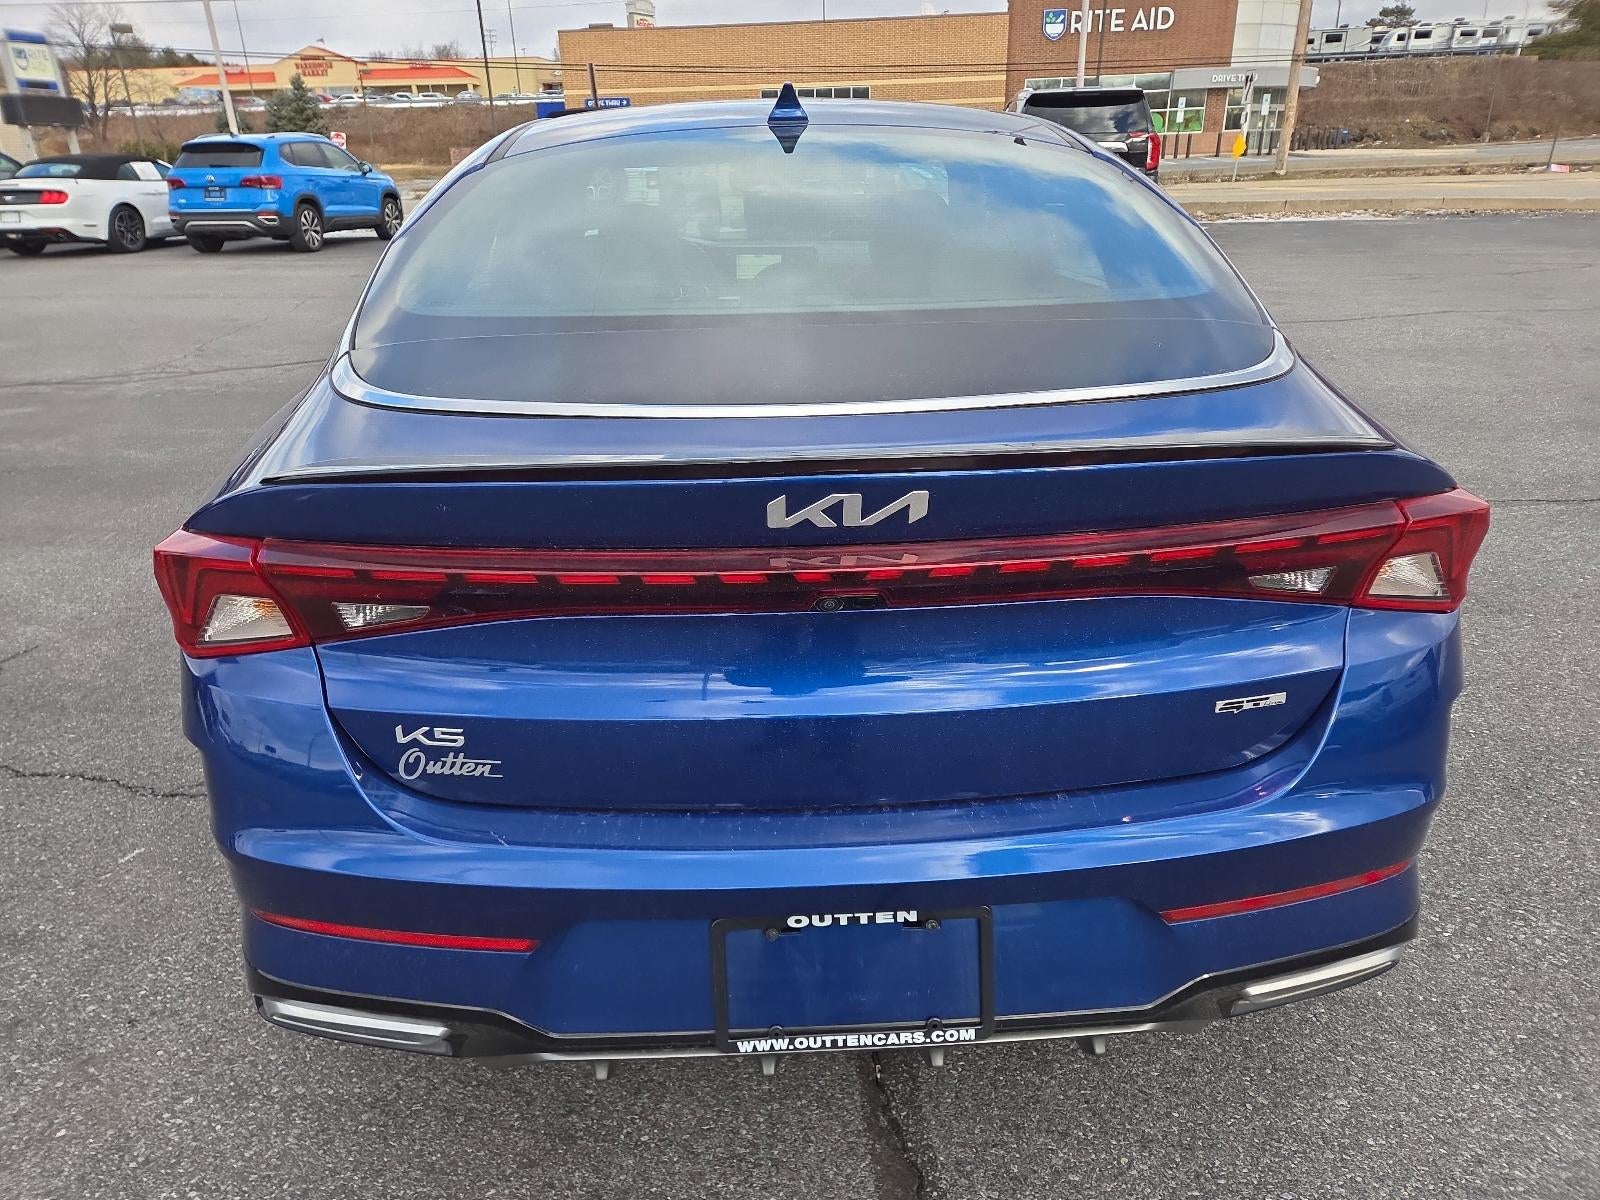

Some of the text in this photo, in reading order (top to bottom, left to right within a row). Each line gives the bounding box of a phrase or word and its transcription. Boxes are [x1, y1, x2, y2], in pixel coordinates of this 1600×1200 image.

[1070, 6, 1175, 34] RITE AID
[1211, 73, 1237, 83] DRIVE
[766, 490, 930, 529] KIA
[395, 724, 465, 747] K5
[398, 747, 504, 780] Outten
[786, 910, 919, 928] OUTTEN
[737, 1028, 977, 1053] WWW.OUTTENCARS.COM
